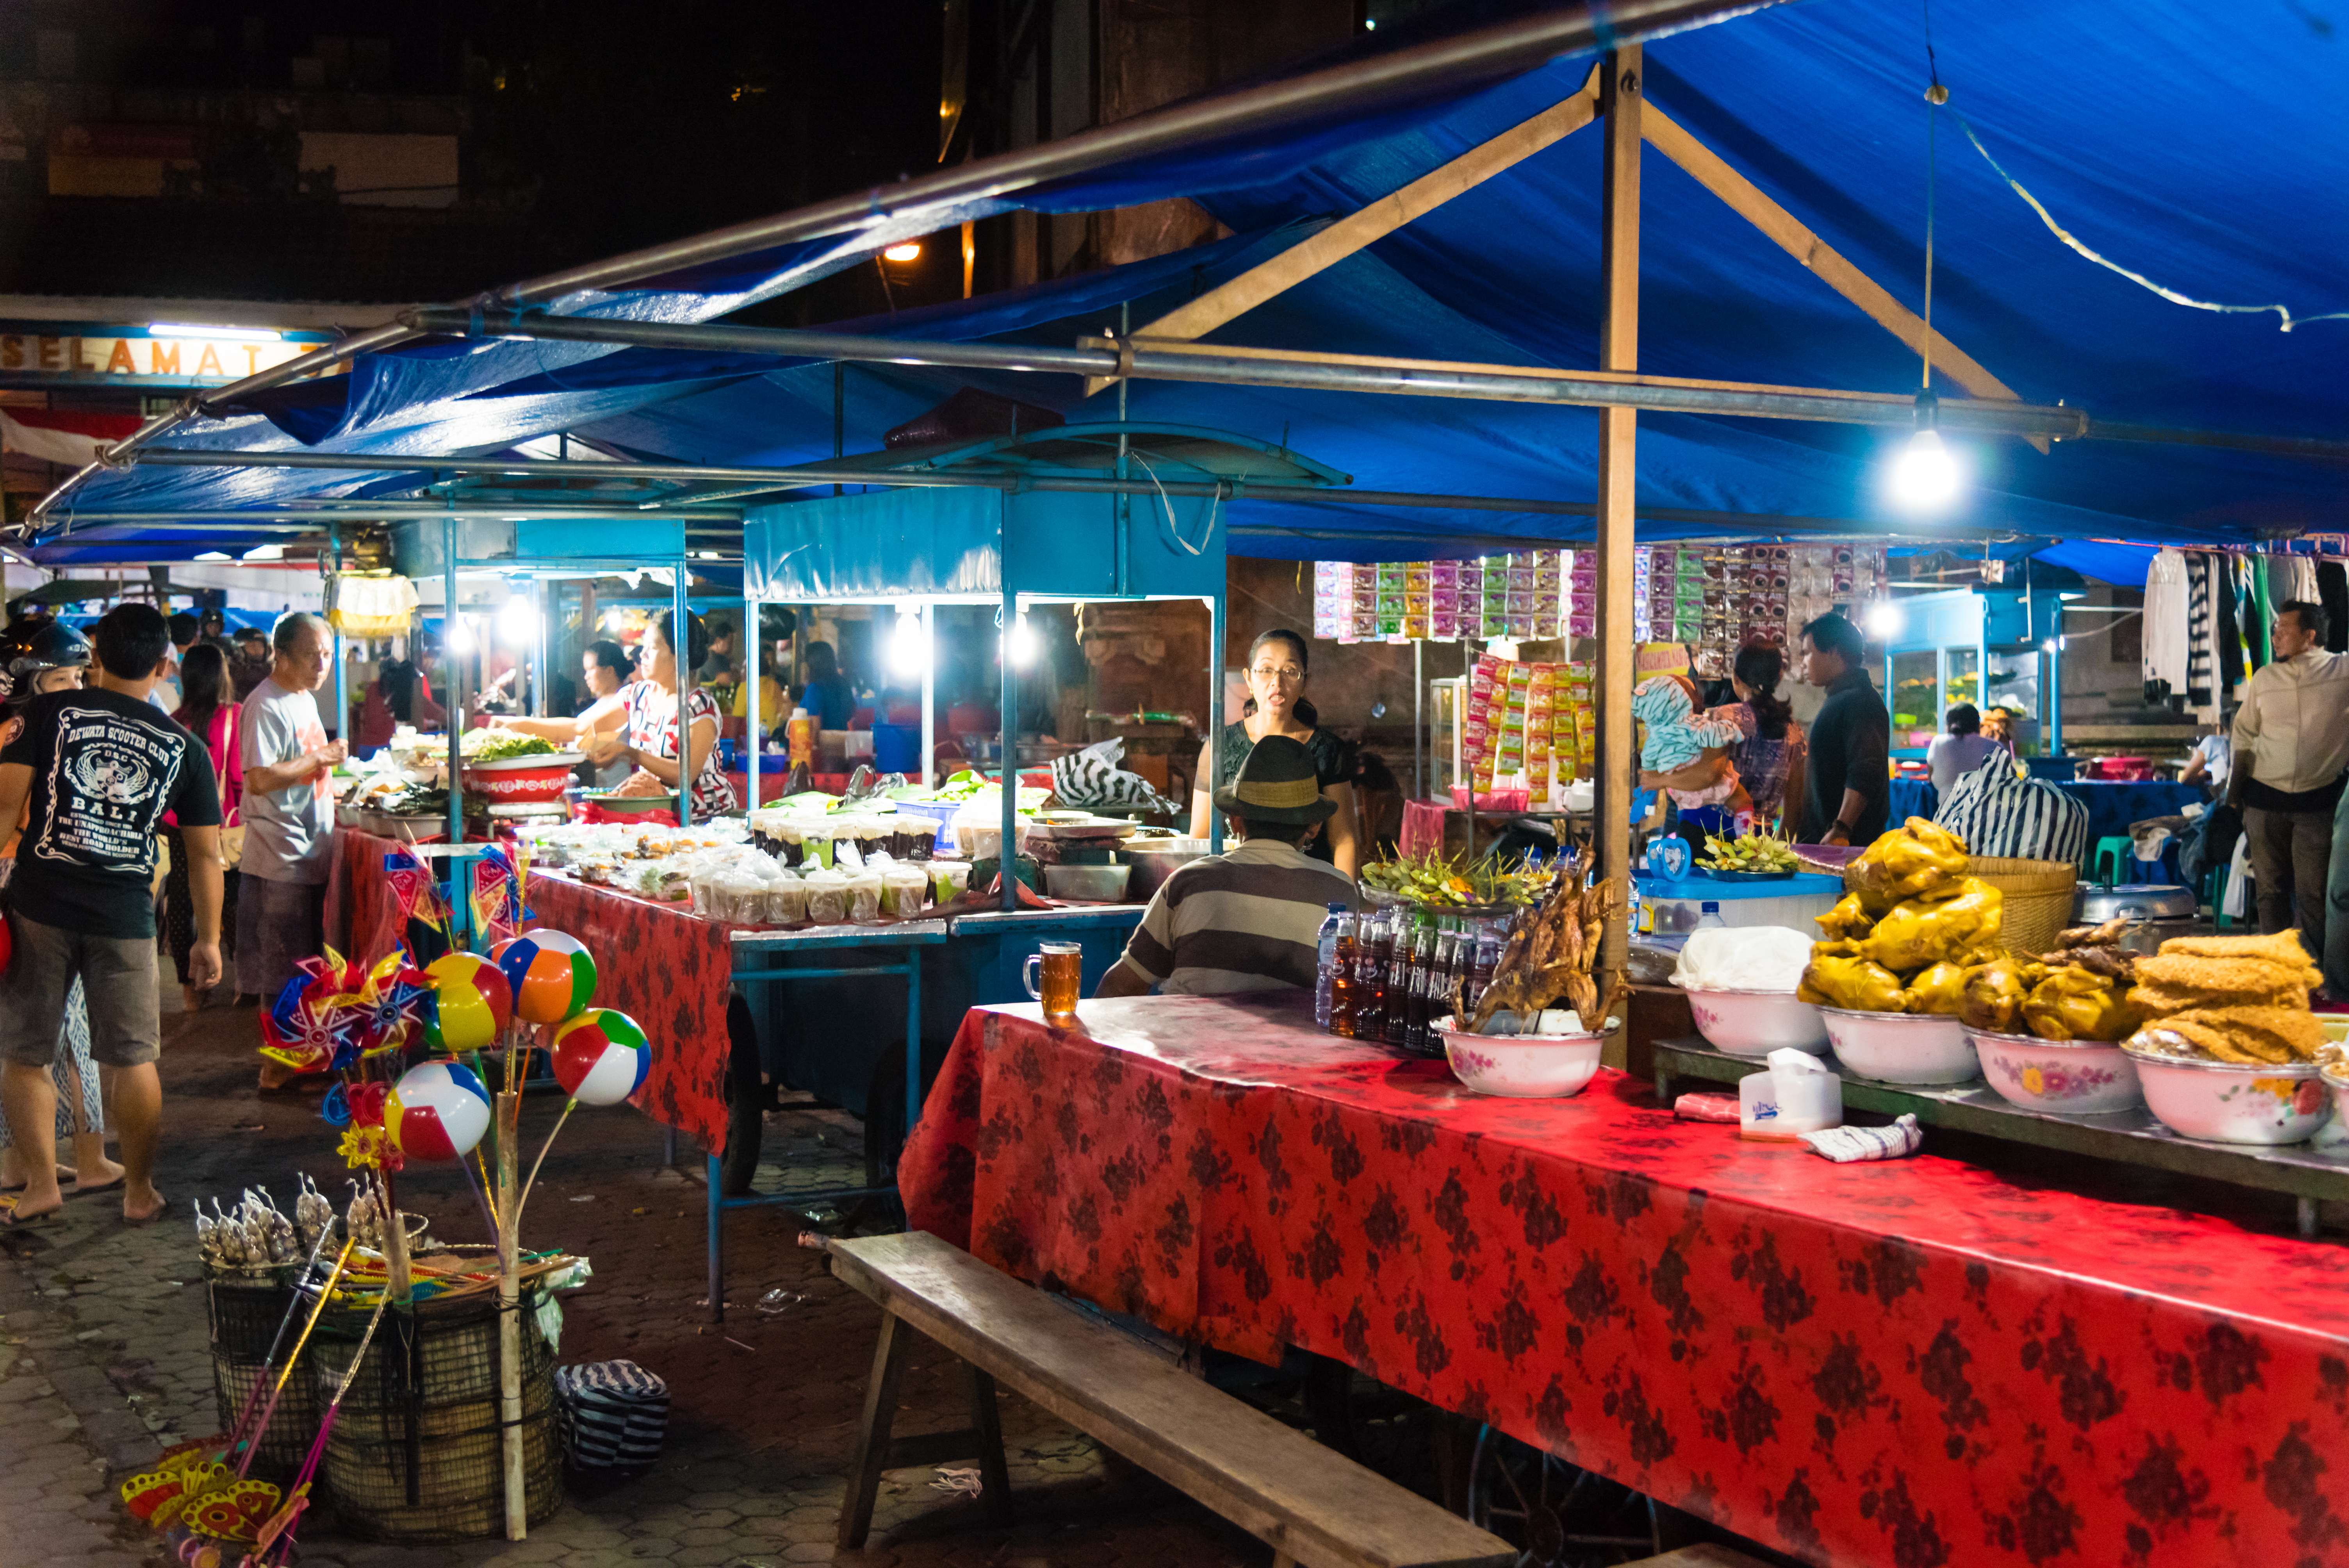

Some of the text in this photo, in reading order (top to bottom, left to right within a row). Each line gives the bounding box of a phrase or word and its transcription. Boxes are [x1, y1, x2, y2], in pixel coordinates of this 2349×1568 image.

[2, 334, 262, 376] SELAMAT
[67, 725, 105, 743] DEWATA
[108, 727, 146, 750] SCOOTER
[148, 741, 169, 766] CLUB
[105, 750, 128, 762] D.S.C
[71, 796, 137, 822] BALI
[58, 816, 72, 825] THE
[75, 820, 143, 840] UNAPPROACHABLE
[73, 828, 127, 845] THE WORLD'S
[59, 832, 140, 854] BEST ROAD HOLDER
